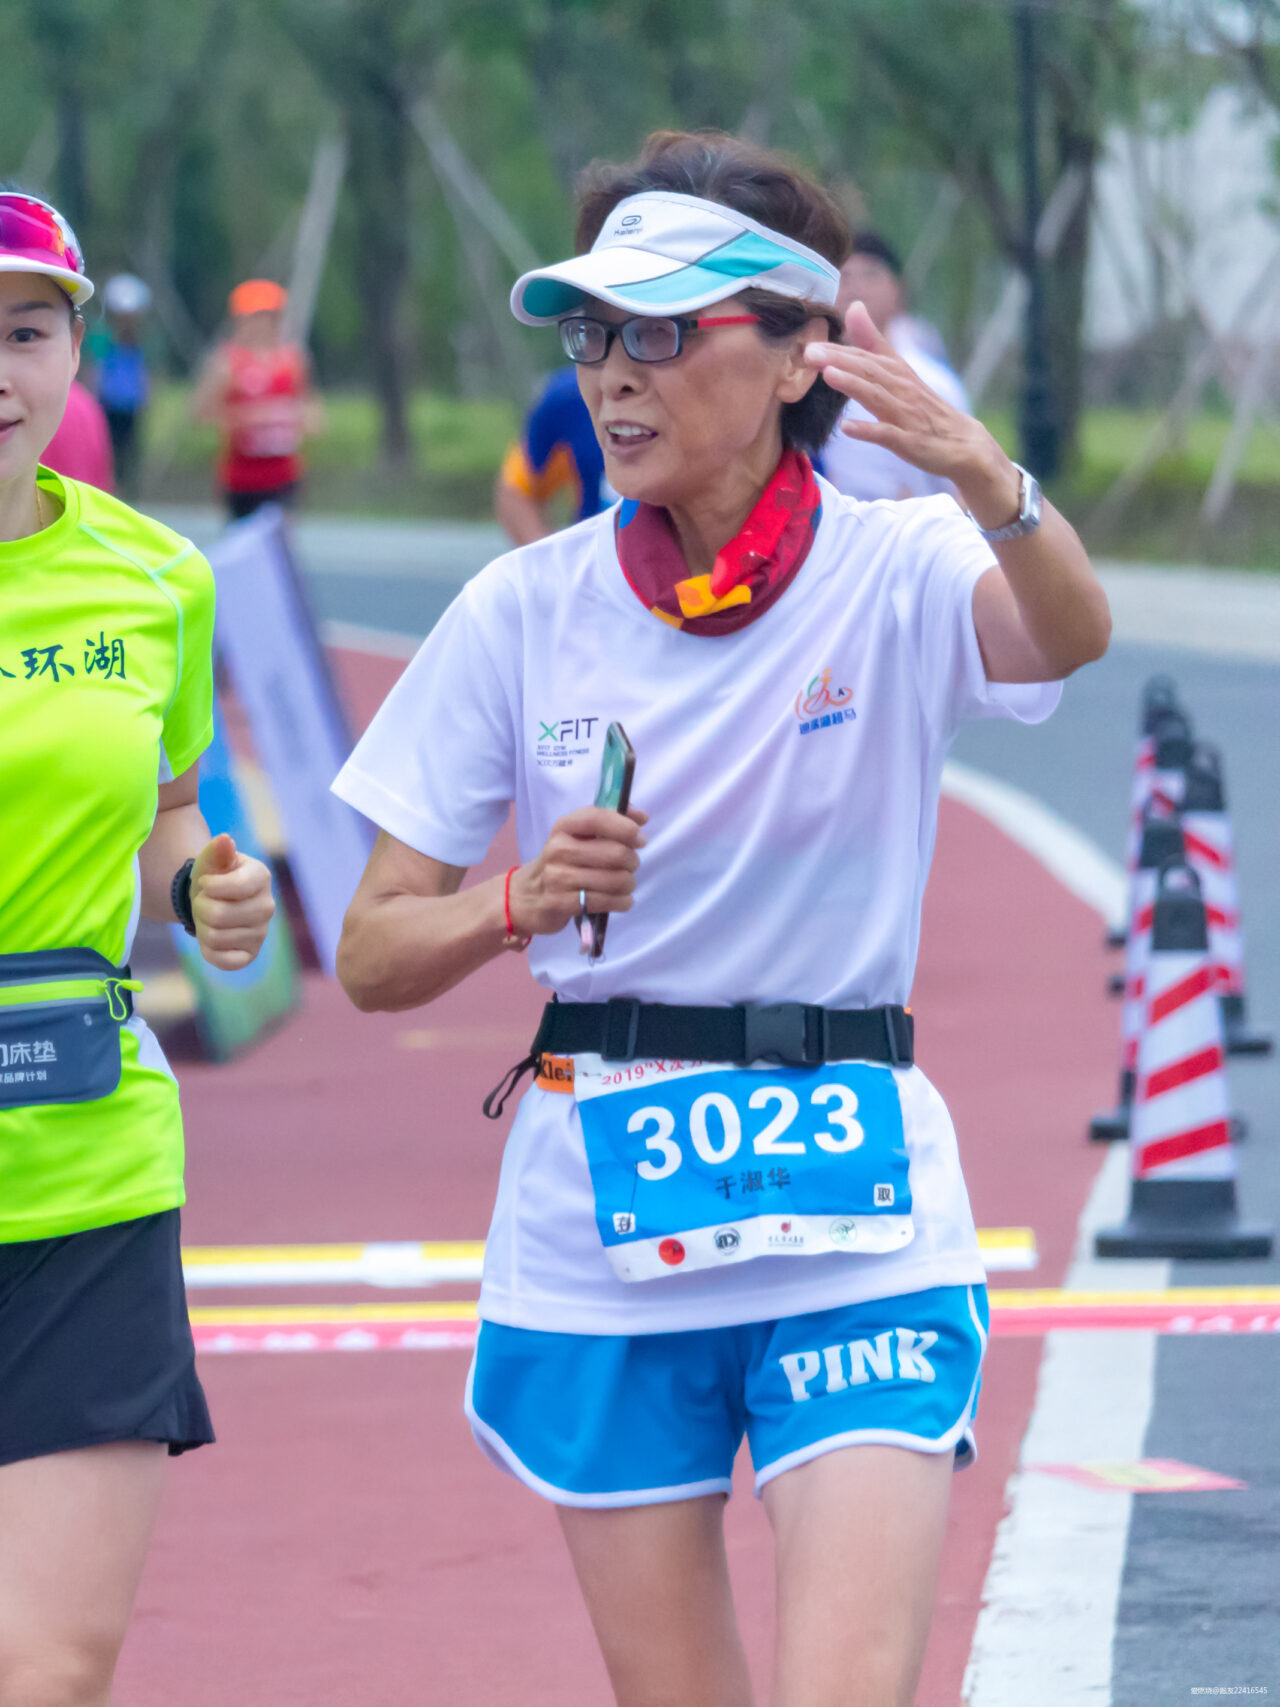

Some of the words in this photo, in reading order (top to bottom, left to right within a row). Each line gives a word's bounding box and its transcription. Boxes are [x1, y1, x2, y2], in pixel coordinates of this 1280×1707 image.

[537, 717, 599, 742] XFIT
[627, 1083, 865, 1181] 3023
[877, 1187, 891, 1202] 取
[778, 1327, 939, 1402] PINK
